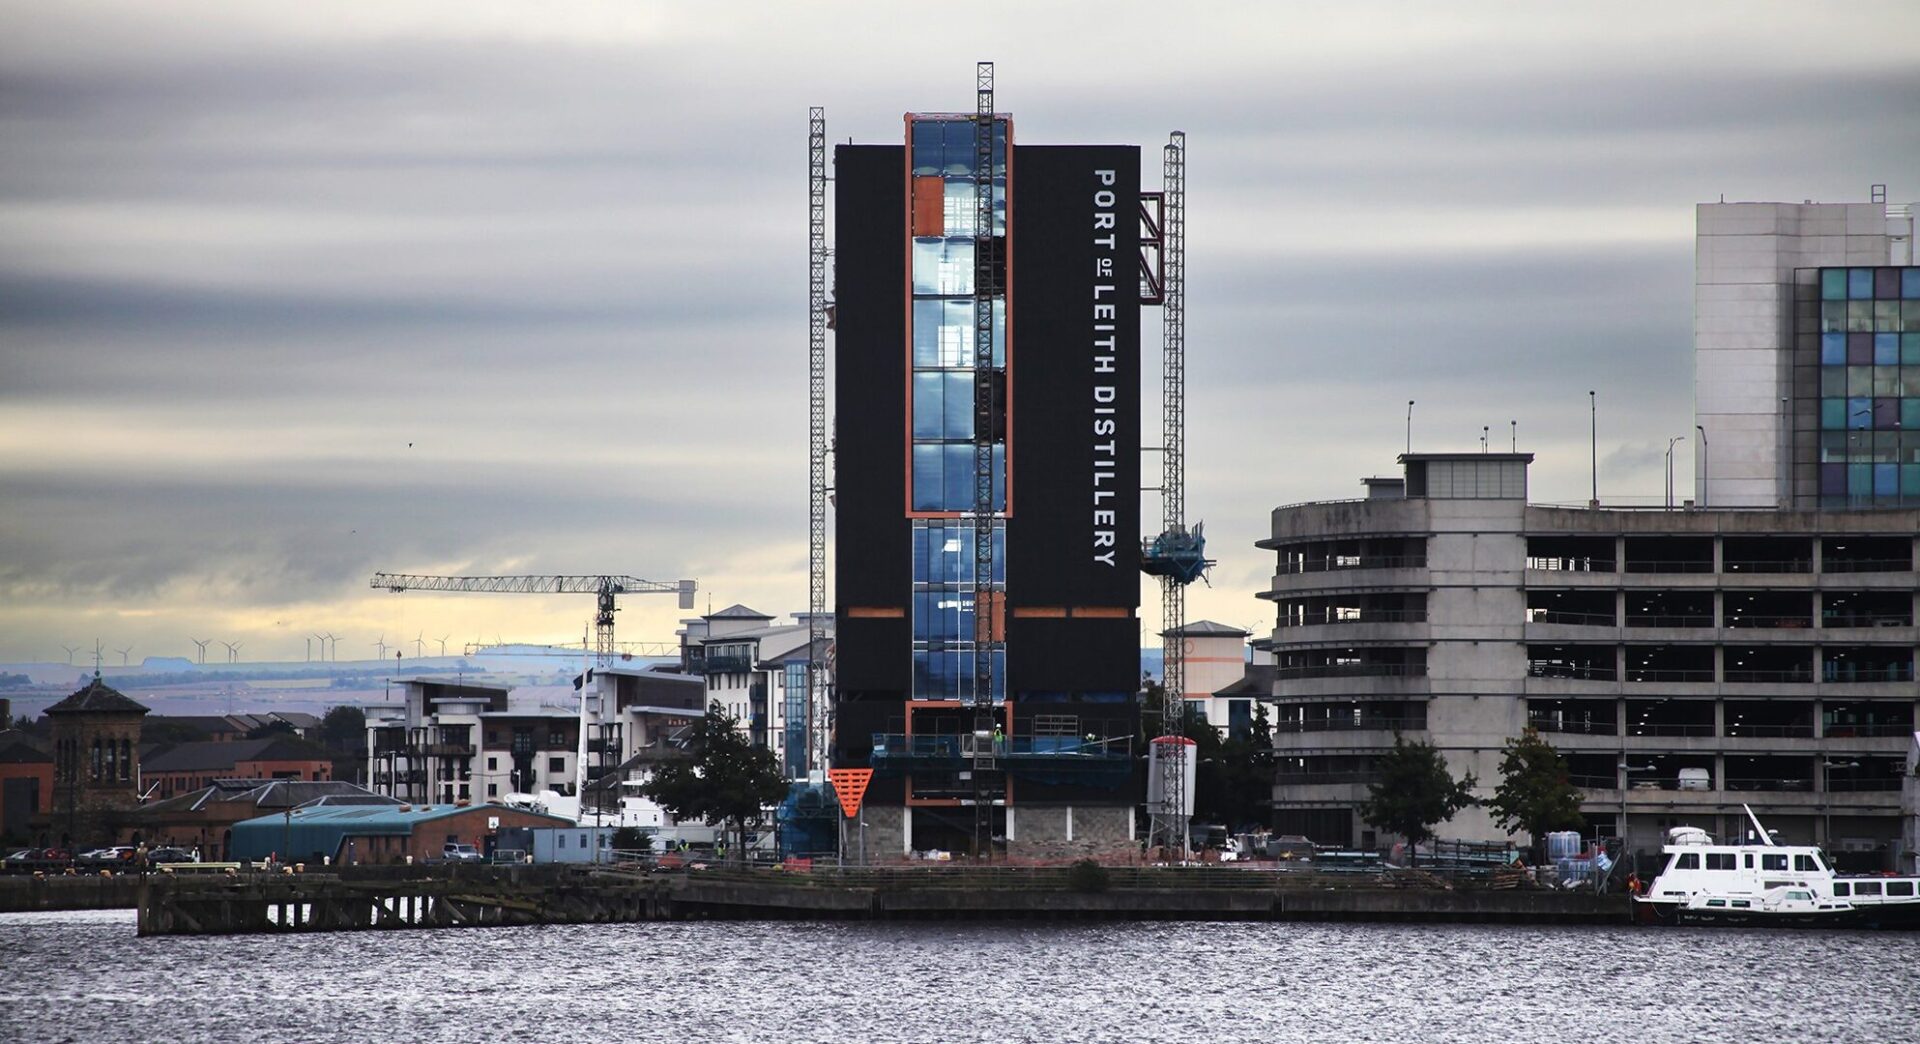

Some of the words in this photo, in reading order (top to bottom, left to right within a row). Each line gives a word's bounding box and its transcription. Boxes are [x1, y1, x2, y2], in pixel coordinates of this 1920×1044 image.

[1094, 169, 1115, 250] PORT
[1100, 258, 1112, 277] OF
[1094, 285, 1115, 373] LEITH
[1094, 386, 1115, 567] DISTILLERY
